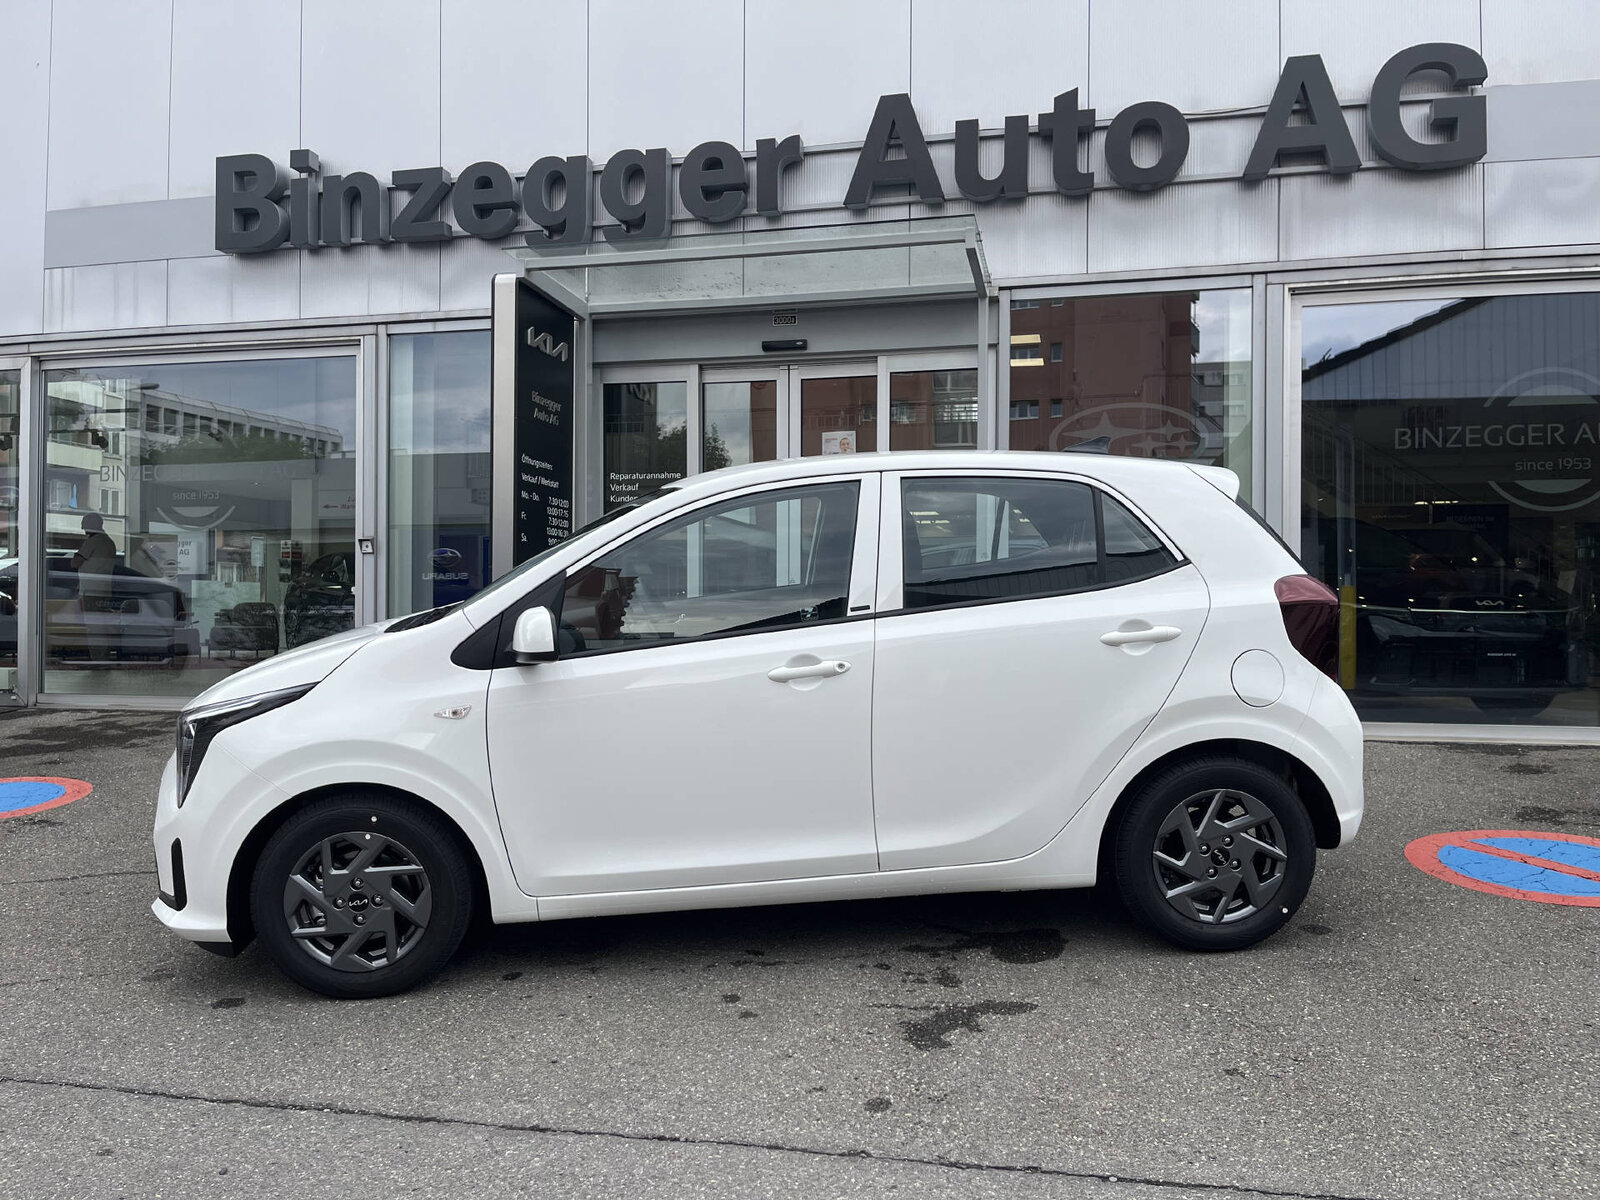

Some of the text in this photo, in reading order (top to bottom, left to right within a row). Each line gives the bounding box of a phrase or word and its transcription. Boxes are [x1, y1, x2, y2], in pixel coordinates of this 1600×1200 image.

[215, 42, 1489, 253] Binzegger Auto AG
[527, 326, 569, 362] KIA
[531, 390, 562, 412] Binzegger
[533, 407, 560, 426] Auto AG
[1394, 424, 1566, 449] BINZEGGER
[1515, 457, 1592, 471] since 1953
[521, 472, 538, 483] Verkauf
[541, 477, 560, 488] Werkstatt
[610, 472, 682, 481] Reparaturannahme
[172, 489, 220, 500] since 1953
[610, 483, 639, 491] Verkauf
